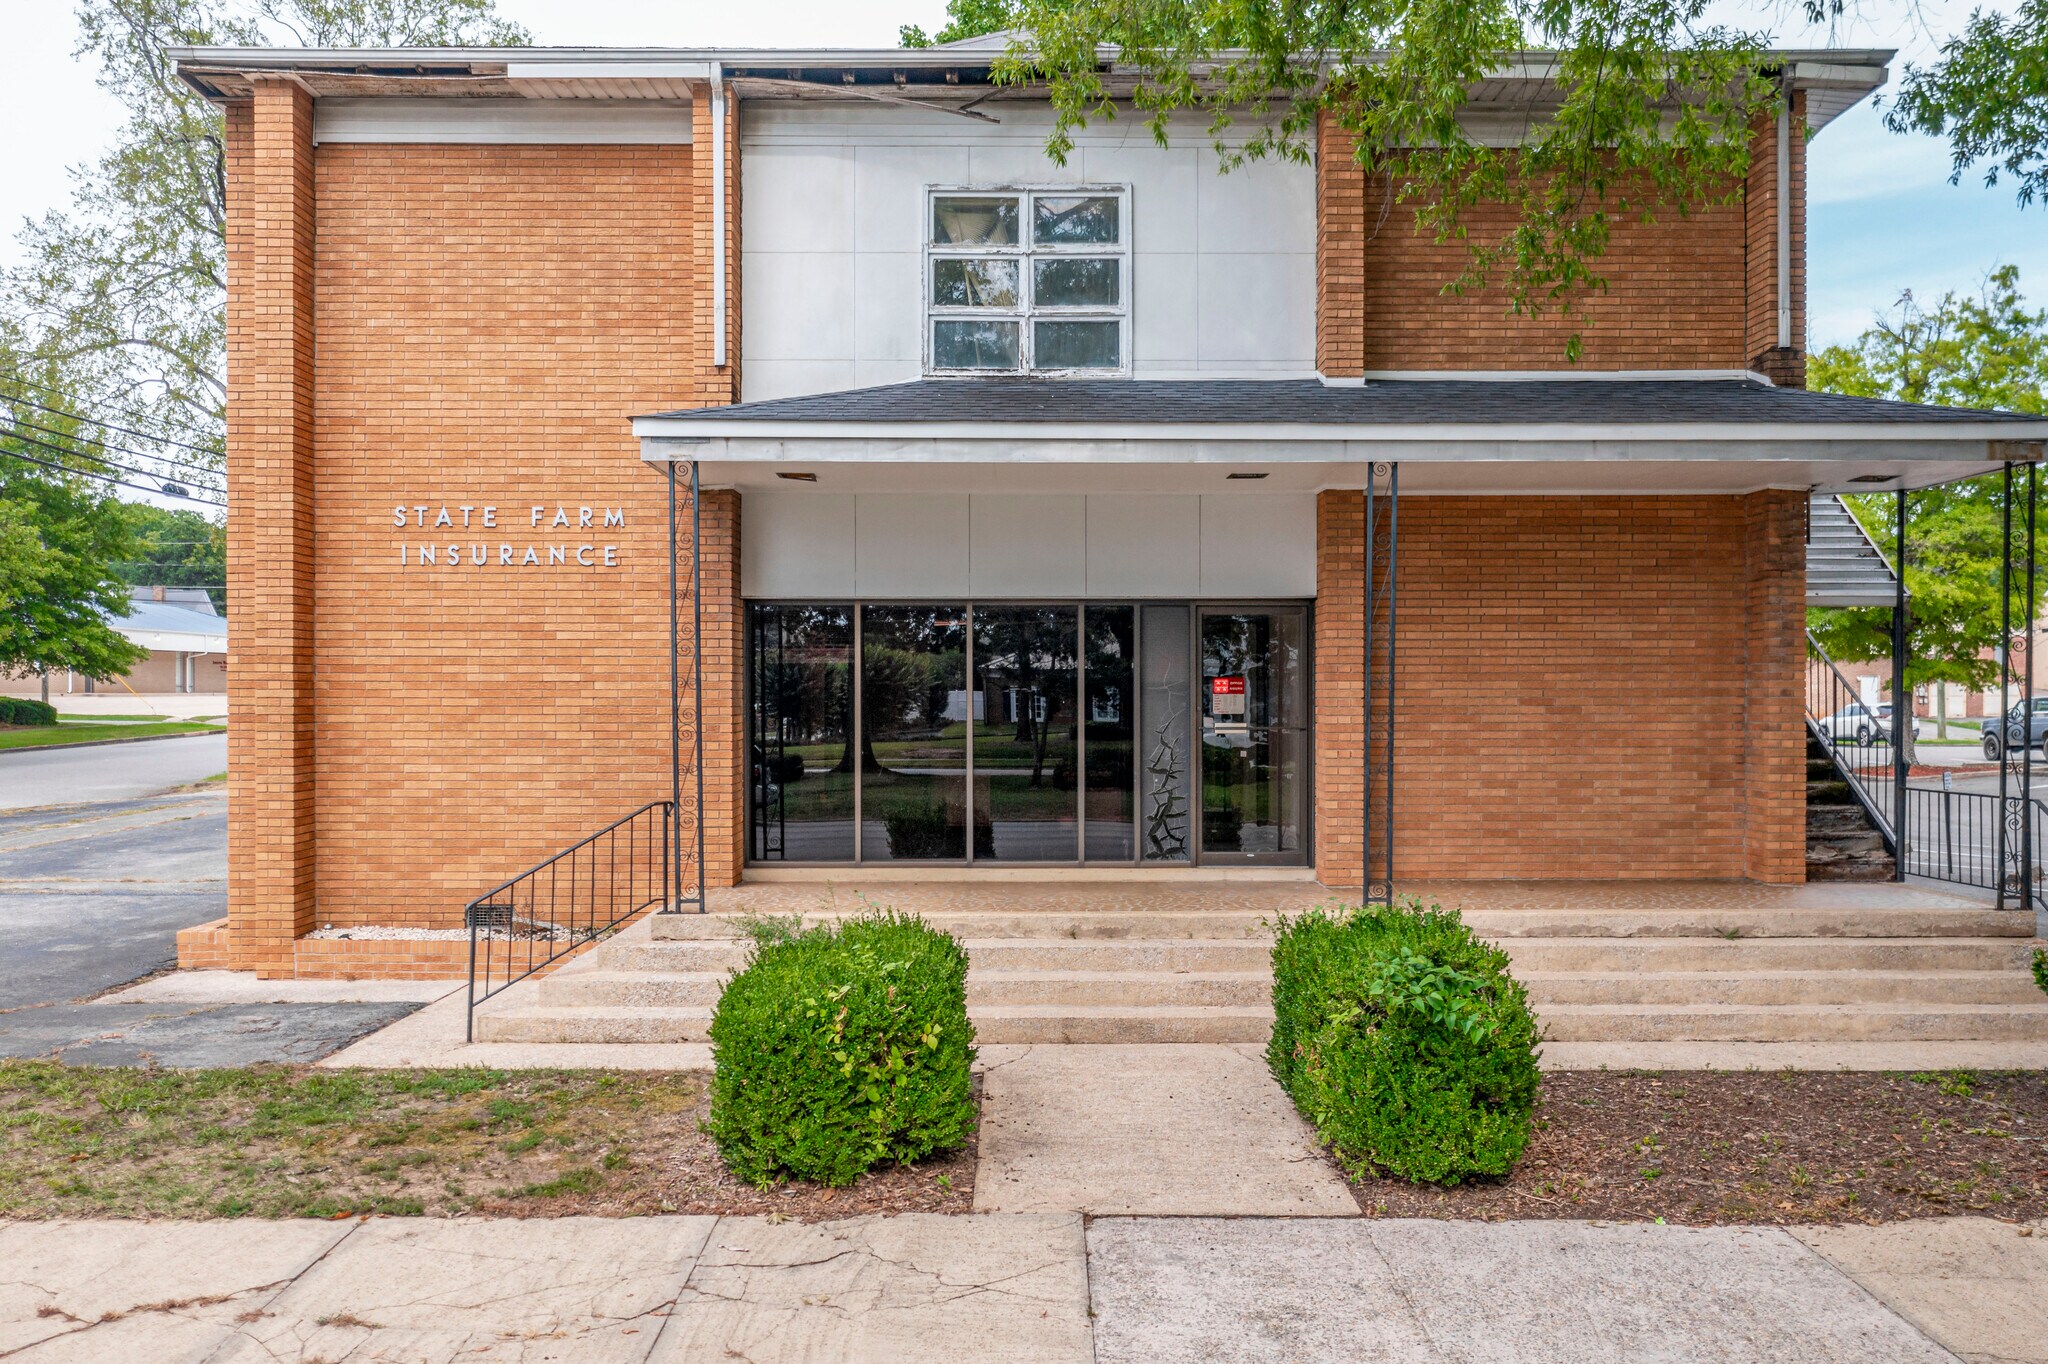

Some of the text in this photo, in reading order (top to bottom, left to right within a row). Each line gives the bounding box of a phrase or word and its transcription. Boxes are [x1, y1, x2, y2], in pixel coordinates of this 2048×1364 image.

[393, 505, 625, 528] STATE FARM
[401, 543, 618, 568] INSURANCE
